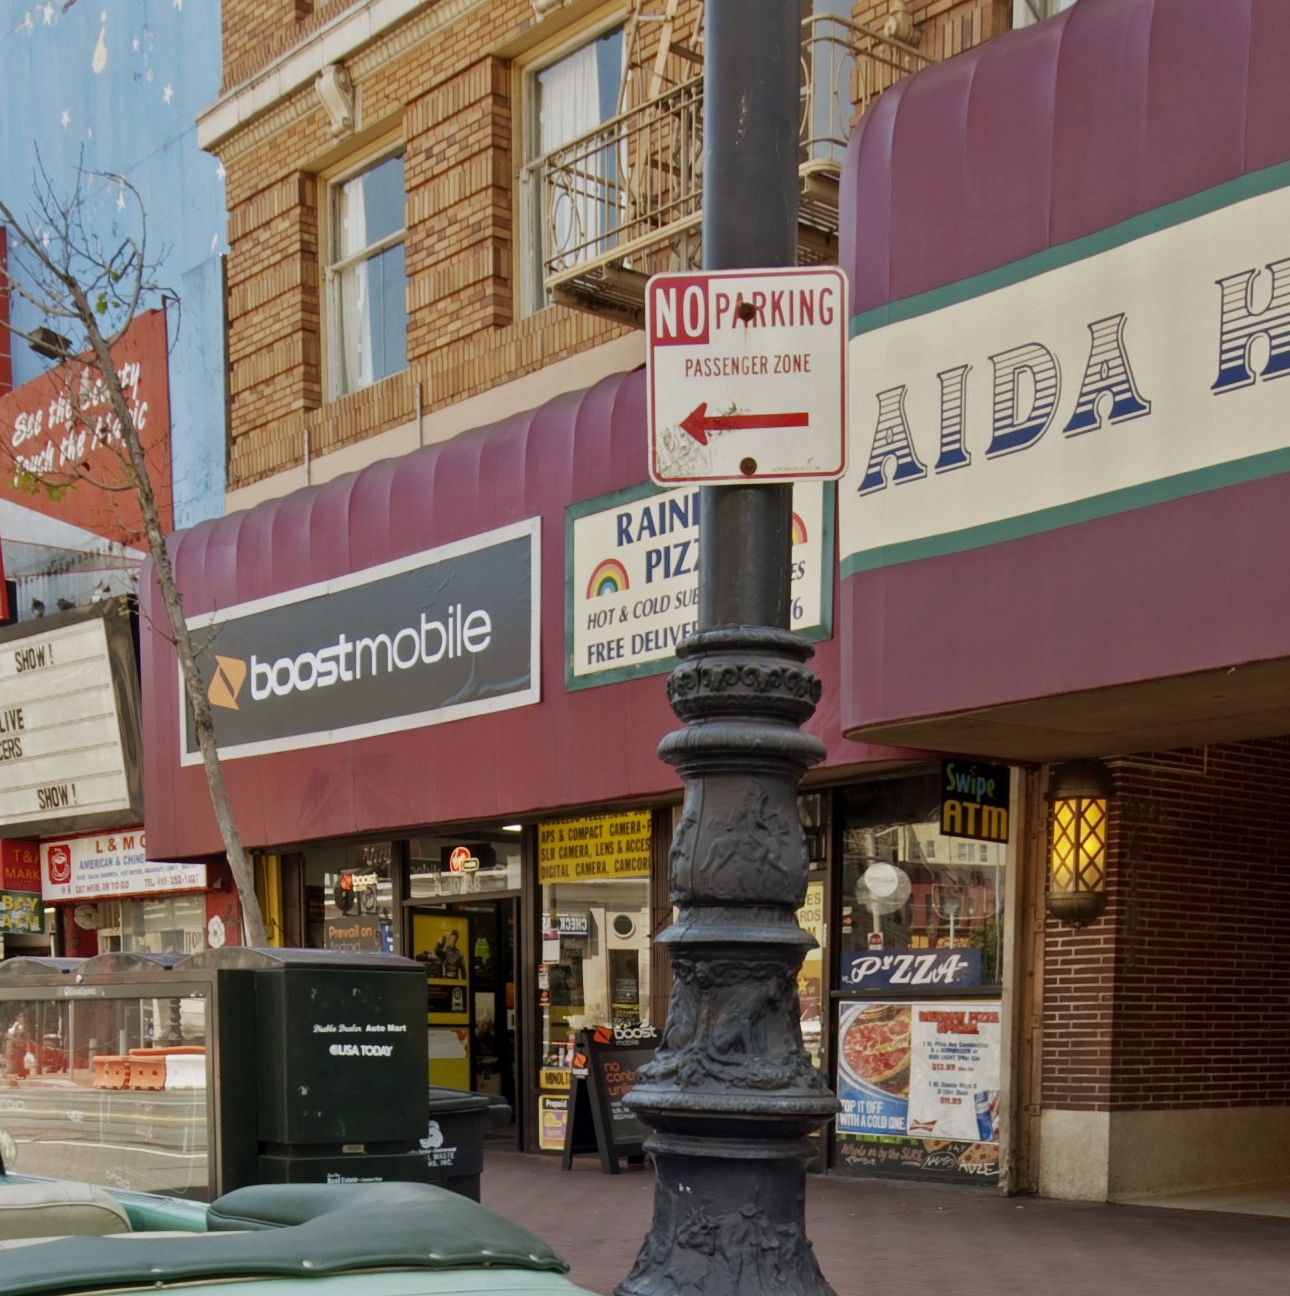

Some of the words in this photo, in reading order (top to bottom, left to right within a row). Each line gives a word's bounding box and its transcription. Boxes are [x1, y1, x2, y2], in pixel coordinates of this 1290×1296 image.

[655, 285, 706, 338] NO
[715, 287, 834, 329] PARKING
[685, 356, 768, 377] PASSENGER
[774, 354, 811, 373] ZONE
[11, 409, 43, 447] See
[48, 391, 72, 429] the
[79, 362, 141, 411] Beaty
[857, 312, 1151, 497] AIDA
[60, 430, 86, 466] the
[91, 400, 148, 451] Maic
[645, 538, 700, 584] PIZ
[587, 608, 615, 630] HOT
[619, 605, 628, 622] &
[633, 594, 671, 619] COLD
[250, 603, 492, 701] boostmobile
[587, 637, 625, 664] FREE
[946, 763, 996, 802] Swipe
[943, 799, 1008, 840] ATM
[541, 829, 555, 843] APS
[559, 828, 564, 842] &
[568, 825, 603, 841] COMPACT
[96, 841, 103, 853] L
[109, 838, 117, 851] &
[123, 836, 134, 850] M
[541, 848, 555, 861] SLR
[559, 845, 592, 860] CAMERA,
[596, 842, 614, 856] LENS
[617, 841, 623, 854] &
[626, 838, 650, 853] ACCES
[79, 856, 113, 870] AMERICAN
[115, 856, 121, 866] &
[541, 864, 569, 879] DIGITAL
[111, 881, 119, 890] TO
[352, 872, 378, 886] boost
[329, 924, 359, 939] Prevail
[361, 927, 373, 938] on
[365, 1024, 385, 1032] Auto
[387, 1024, 407, 1032] Mart
[614, 1025, 657, 1040] boost
[338, 1044, 360, 1056] USA
[360, 1045, 393, 1056] TODAY
[604, 1062, 620, 1072] no
[608, 1085, 633, 1096] unli
[546, 1098, 567, 1109] Prepaid
[858, 1101, 864, 1113] IT
[866, 1101, 883, 1113] OFF
[840, 1113, 859, 1126] WITH
[861, 1115, 867, 1127] A
[868, 1115, 887, 1128] COLD
